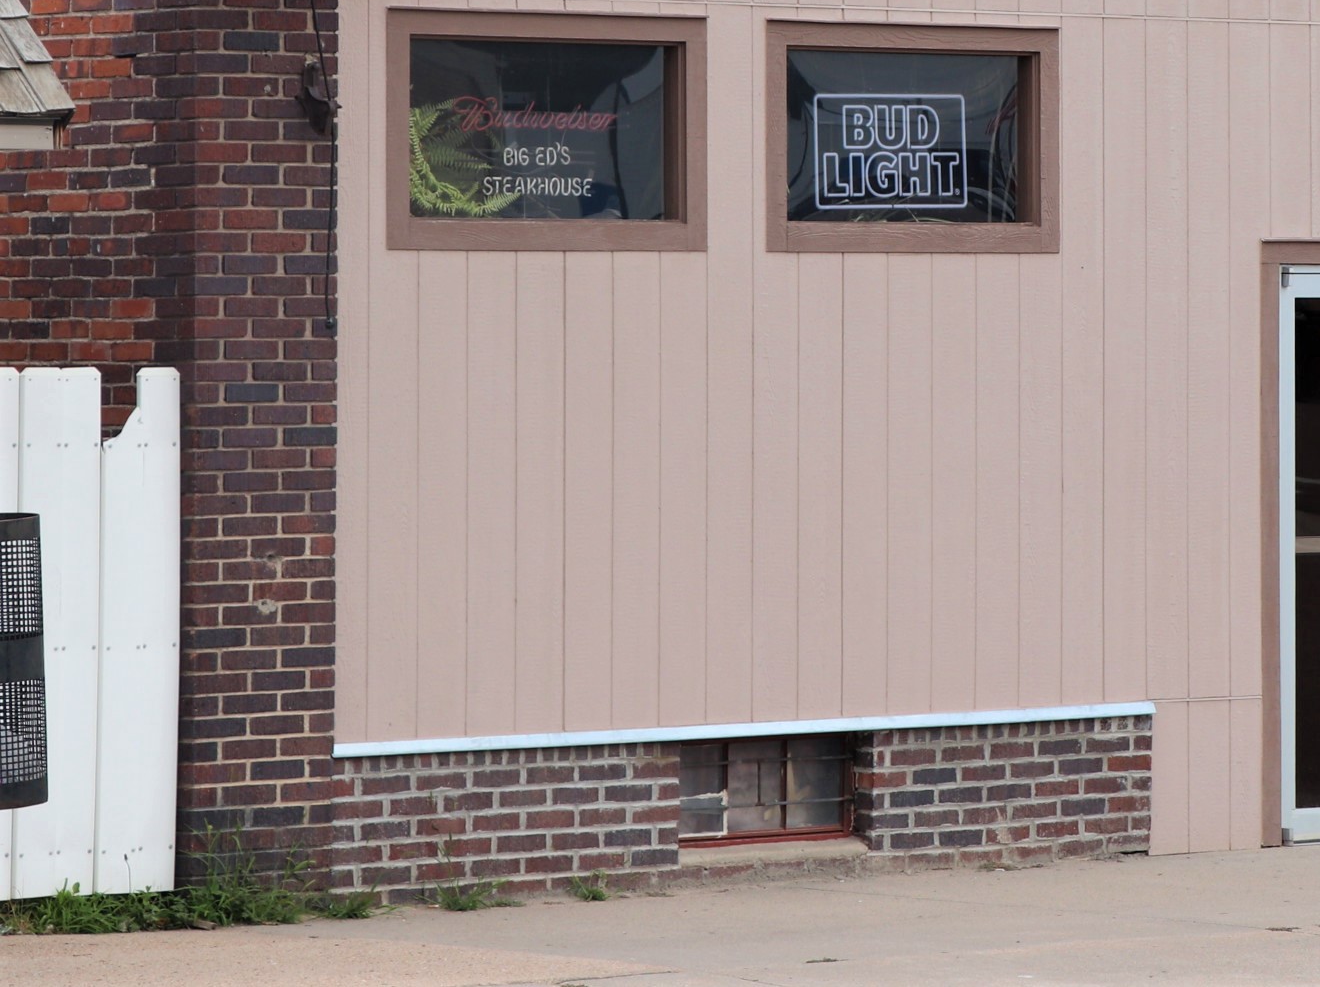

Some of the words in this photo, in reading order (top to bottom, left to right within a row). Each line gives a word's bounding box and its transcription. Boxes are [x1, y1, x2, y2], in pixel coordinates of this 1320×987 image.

[452, 96, 617, 132] Budweiser
[842, 105, 940, 150] BUD
[503, 147, 529, 167] BIG
[535, 142, 571, 166] ED'S
[482, 177, 593, 197] STEAKHOUSE
[823, 151, 959, 198] LIGHT
